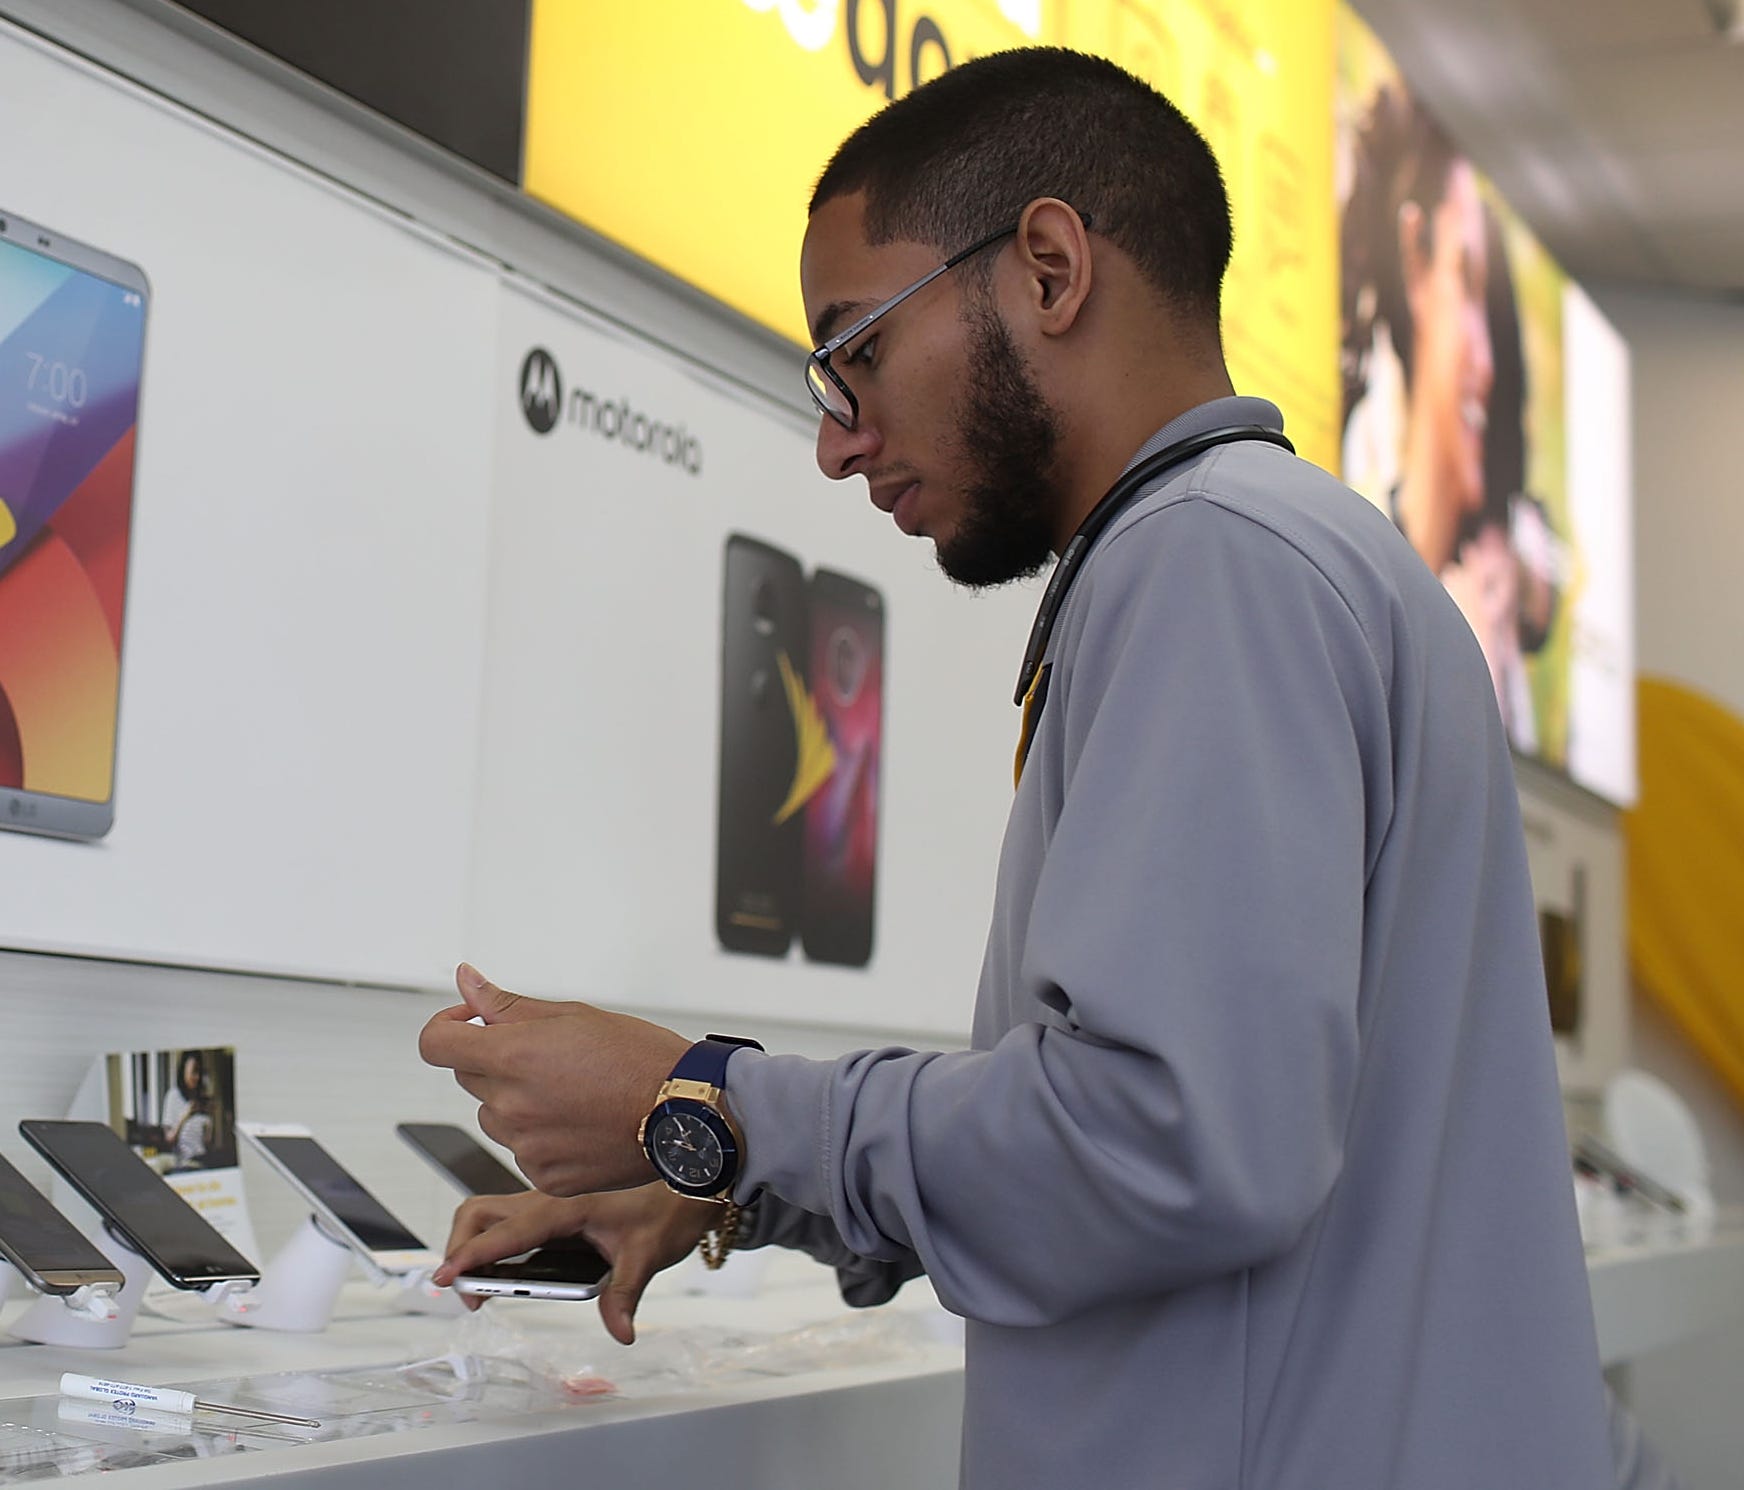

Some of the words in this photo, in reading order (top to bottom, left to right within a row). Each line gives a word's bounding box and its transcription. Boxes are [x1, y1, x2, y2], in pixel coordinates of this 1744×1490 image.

[25, 352, 88, 408] 7:00
[567, 386, 703, 476] motorola
[89, 1385, 109, 1394] GLOBAL
